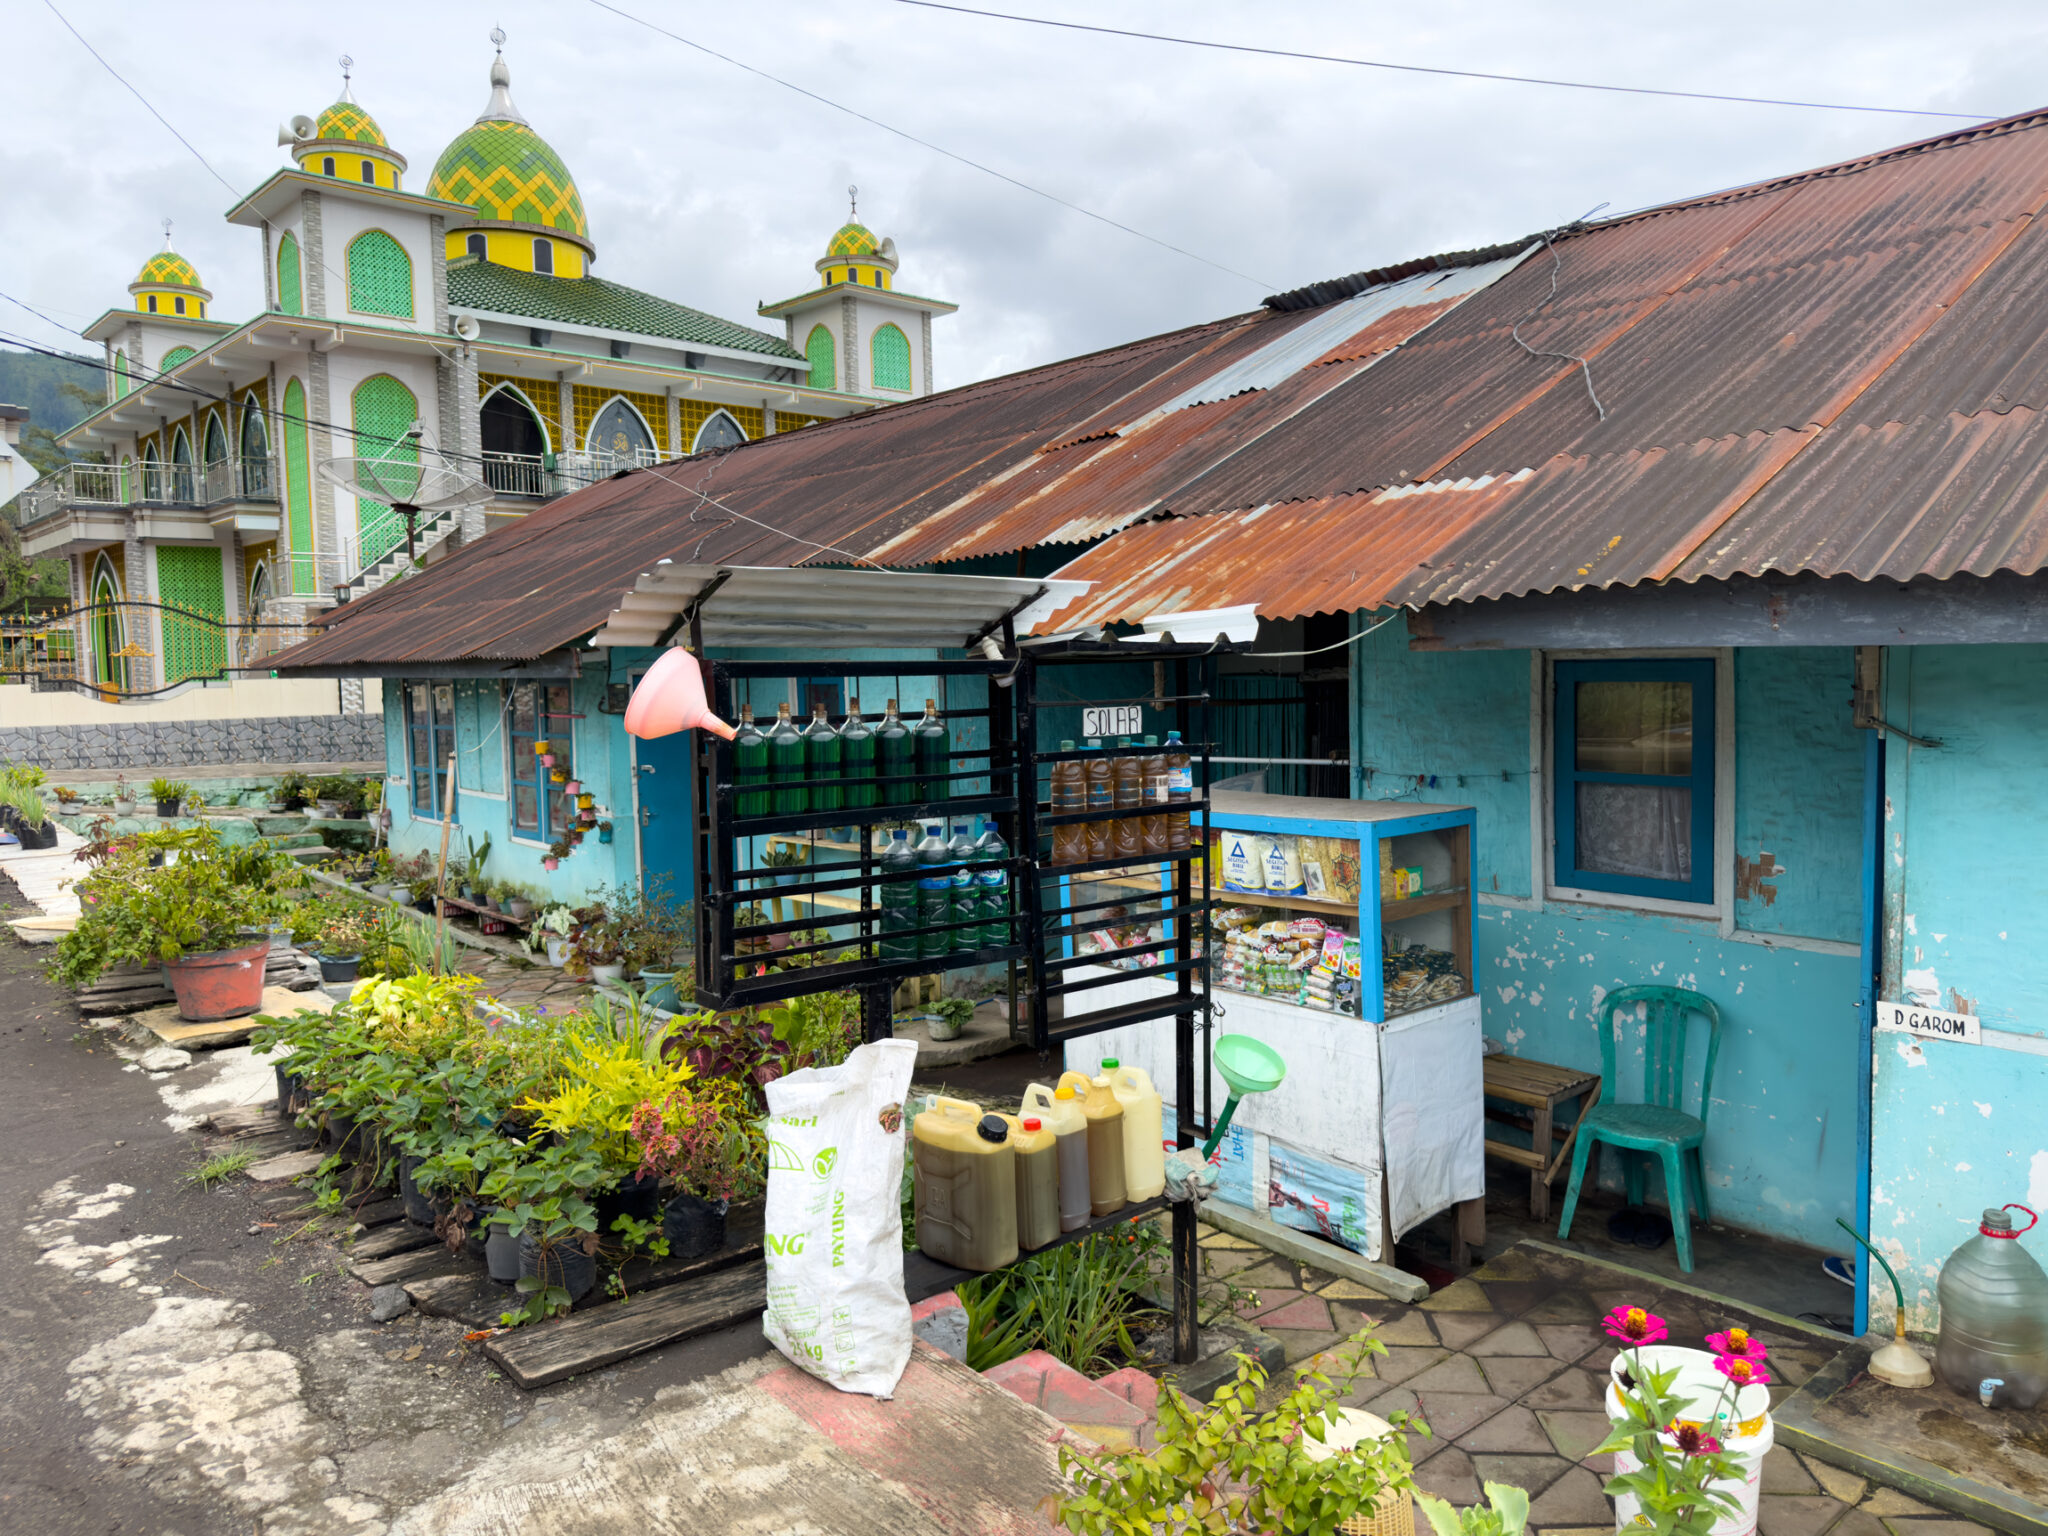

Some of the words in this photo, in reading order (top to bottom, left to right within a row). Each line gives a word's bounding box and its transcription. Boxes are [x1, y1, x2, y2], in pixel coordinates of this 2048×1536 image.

[1086, 706, 1139, 736] SOLAR
[1894, 1009, 1904, 1025] D
[1909, 1013, 1966, 1036] GAROM
[831, 1188, 845, 1268] PAYUNG
[804, 1341, 823, 1361] kg
